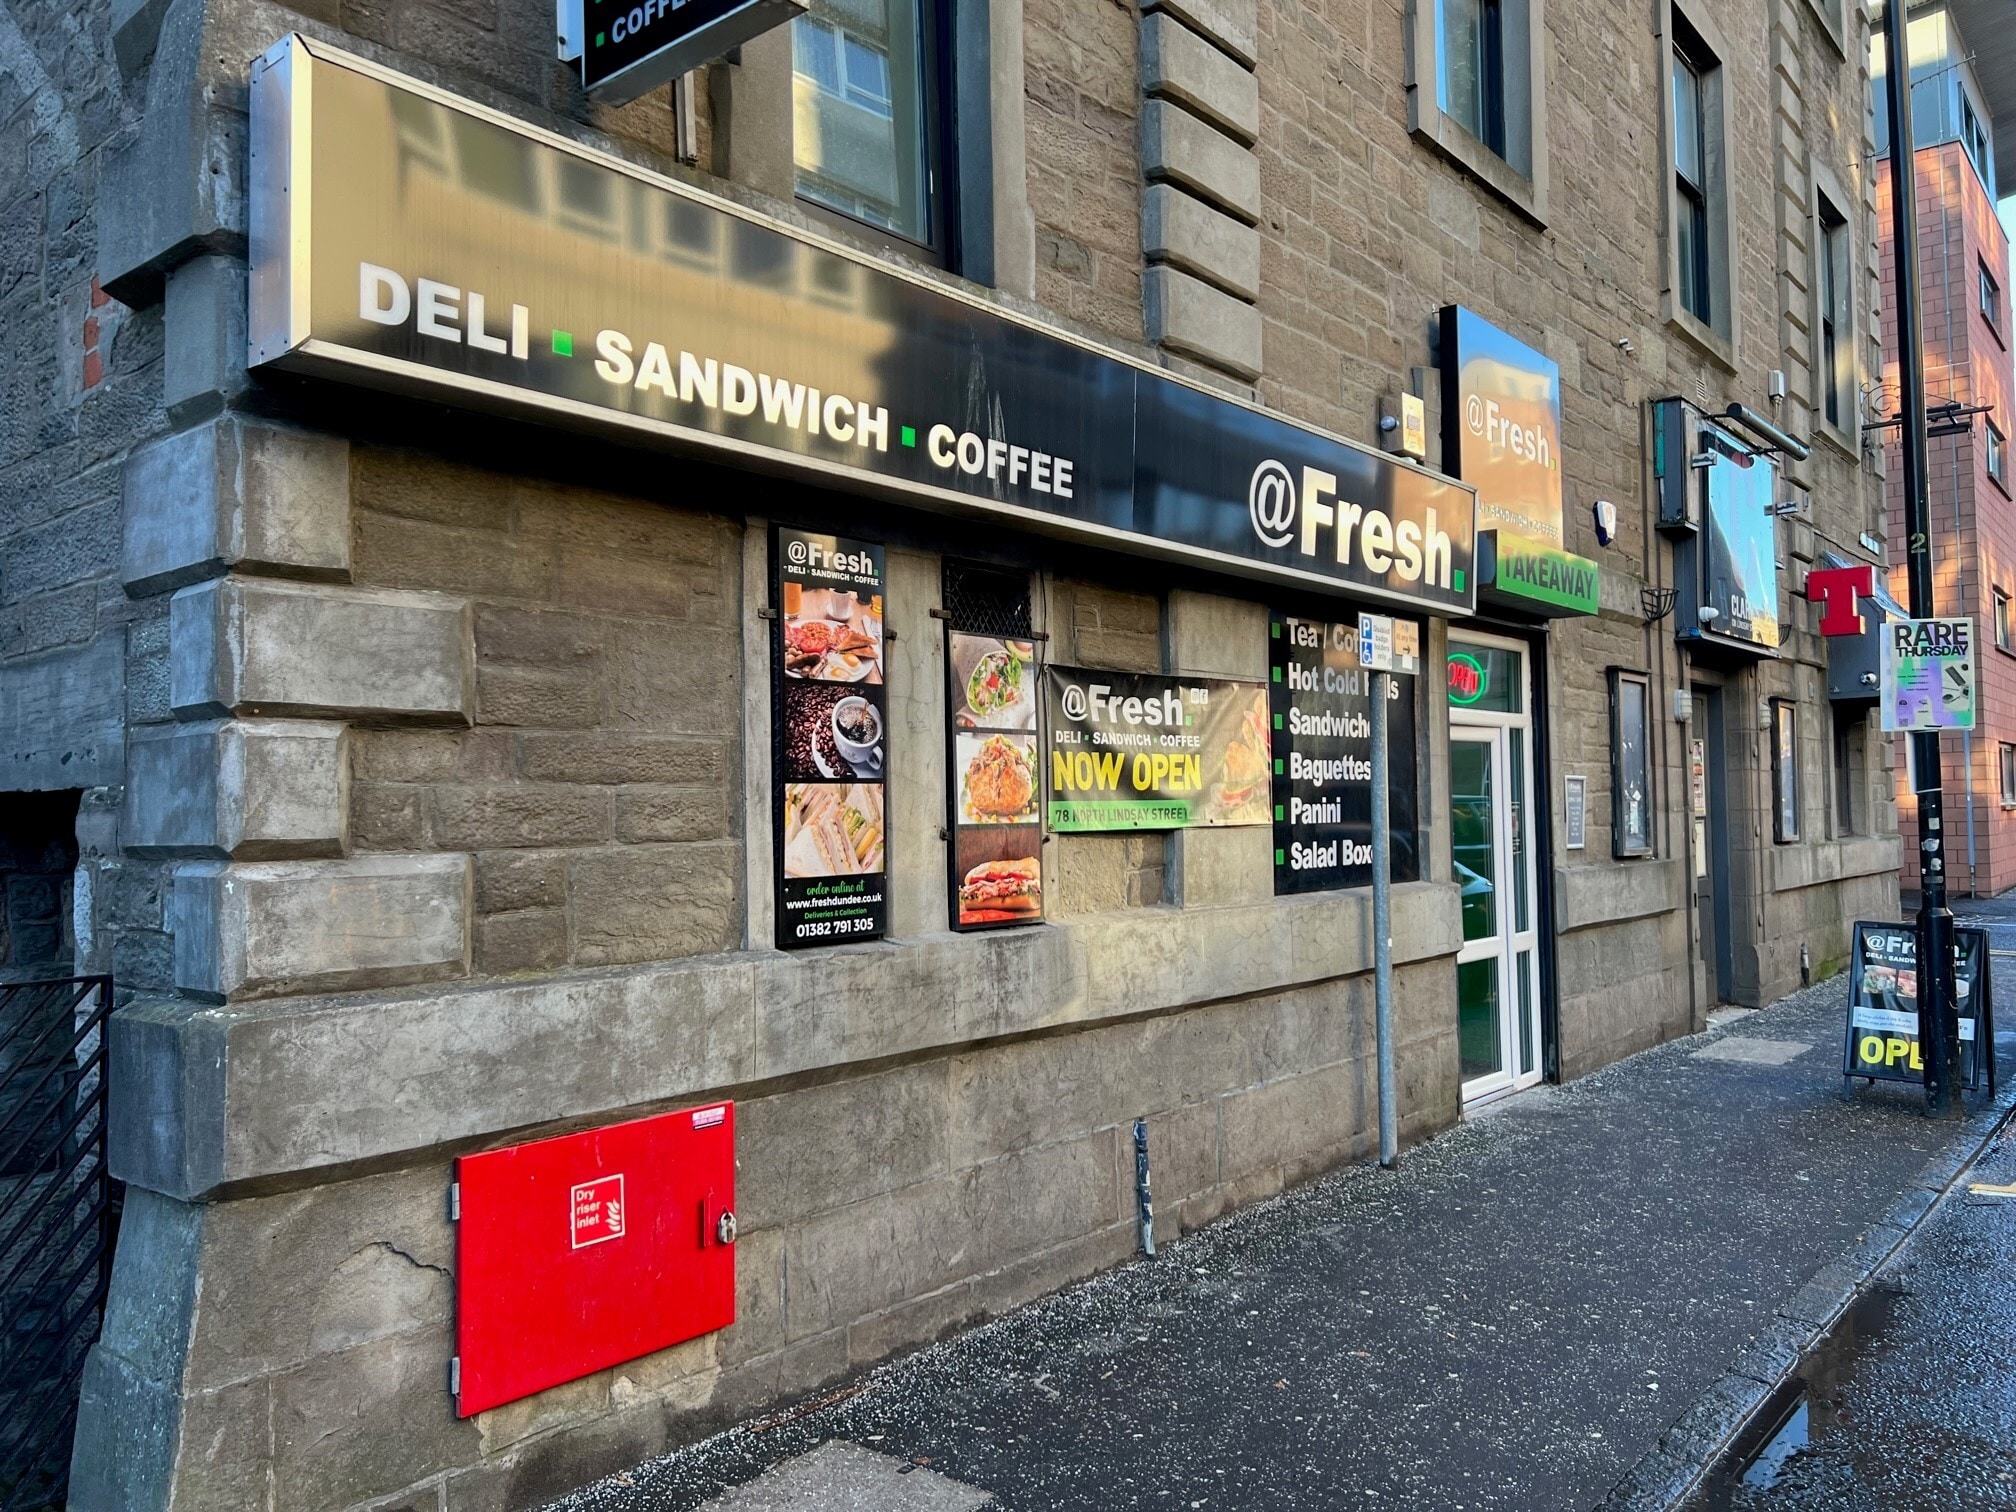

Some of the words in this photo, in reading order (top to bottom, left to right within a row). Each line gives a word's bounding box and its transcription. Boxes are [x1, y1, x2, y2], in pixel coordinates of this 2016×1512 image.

[611, 0, 692, 43] COFF
[359, 261, 530, 360] DELI
[594, 328, 889, 452] SANDWICH
[927, 423, 1074, 499] COFFEE
[1478, 501, 1486, 513] LI
[1490, 504, 1528, 529] SANDWICH
[1534, 520, 1558, 540] COFFEE
[1911, 532, 1926, 554] 2
[788, 565, 806, 575] DELI
[811, 568, 850, 581] SANDWICH
[854, 575, 879, 586] COFFEE
[1502, 545, 1594, 600] TAKEAWAY
[1286, 616, 1318, 649] Tea
[1333, 624, 1359, 654] Cof
[1363, 619, 1371, 637] P
[1894, 622, 1968, 647] RARE
[1895, 644, 1969, 658] THURSDAY
[1288, 662, 1319, 692] Hot
[1324, 666, 1359, 696] Cold
[1448, 662, 1478, 695] OPEN
[1289, 706, 1370, 739] Sandwich
[1055, 730, 1081, 744] DELI
[1092, 731, 1151, 746] SANDWICH
[1159, 734, 1201, 747] COFFEE
[1052, 751, 1125, 791] NOW
[1132, 752, 1203, 791] OPEN
[1290, 751, 1371, 787] Baguettes
[1055, 809, 1069, 823] 78
[1072, 808, 1106, 822] NORTH
[1108, 808, 1149, 822] LINDSAY
[1152, 807, 1188, 821] STREET
[1290, 796, 1341, 825] Panini
[1290, 840, 1338, 870] Salad
[1342, 839, 1373, 866] Box
[806, 881, 830, 896] order
[831, 880, 855, 894] online
[855, 879, 865, 893] at
[786, 892, 882, 909] www.freshdundee.co.uk
[804, 909, 834, 919] Deliveries
[839, 907, 867, 917] Collection
[796, 922, 831, 938] 01382
[833, 919, 852, 934] 791
[853, 917, 874, 932] 305
[1865, 951, 1883, 960] DELI
[1888, 955, 1916, 964] SANDW
[1860, 1035, 1924, 1071] OPE
[576, 1189, 595, 1202] Dry
[576, 1201, 601, 1216] riser
[577, 1213, 600, 1229] inlet
